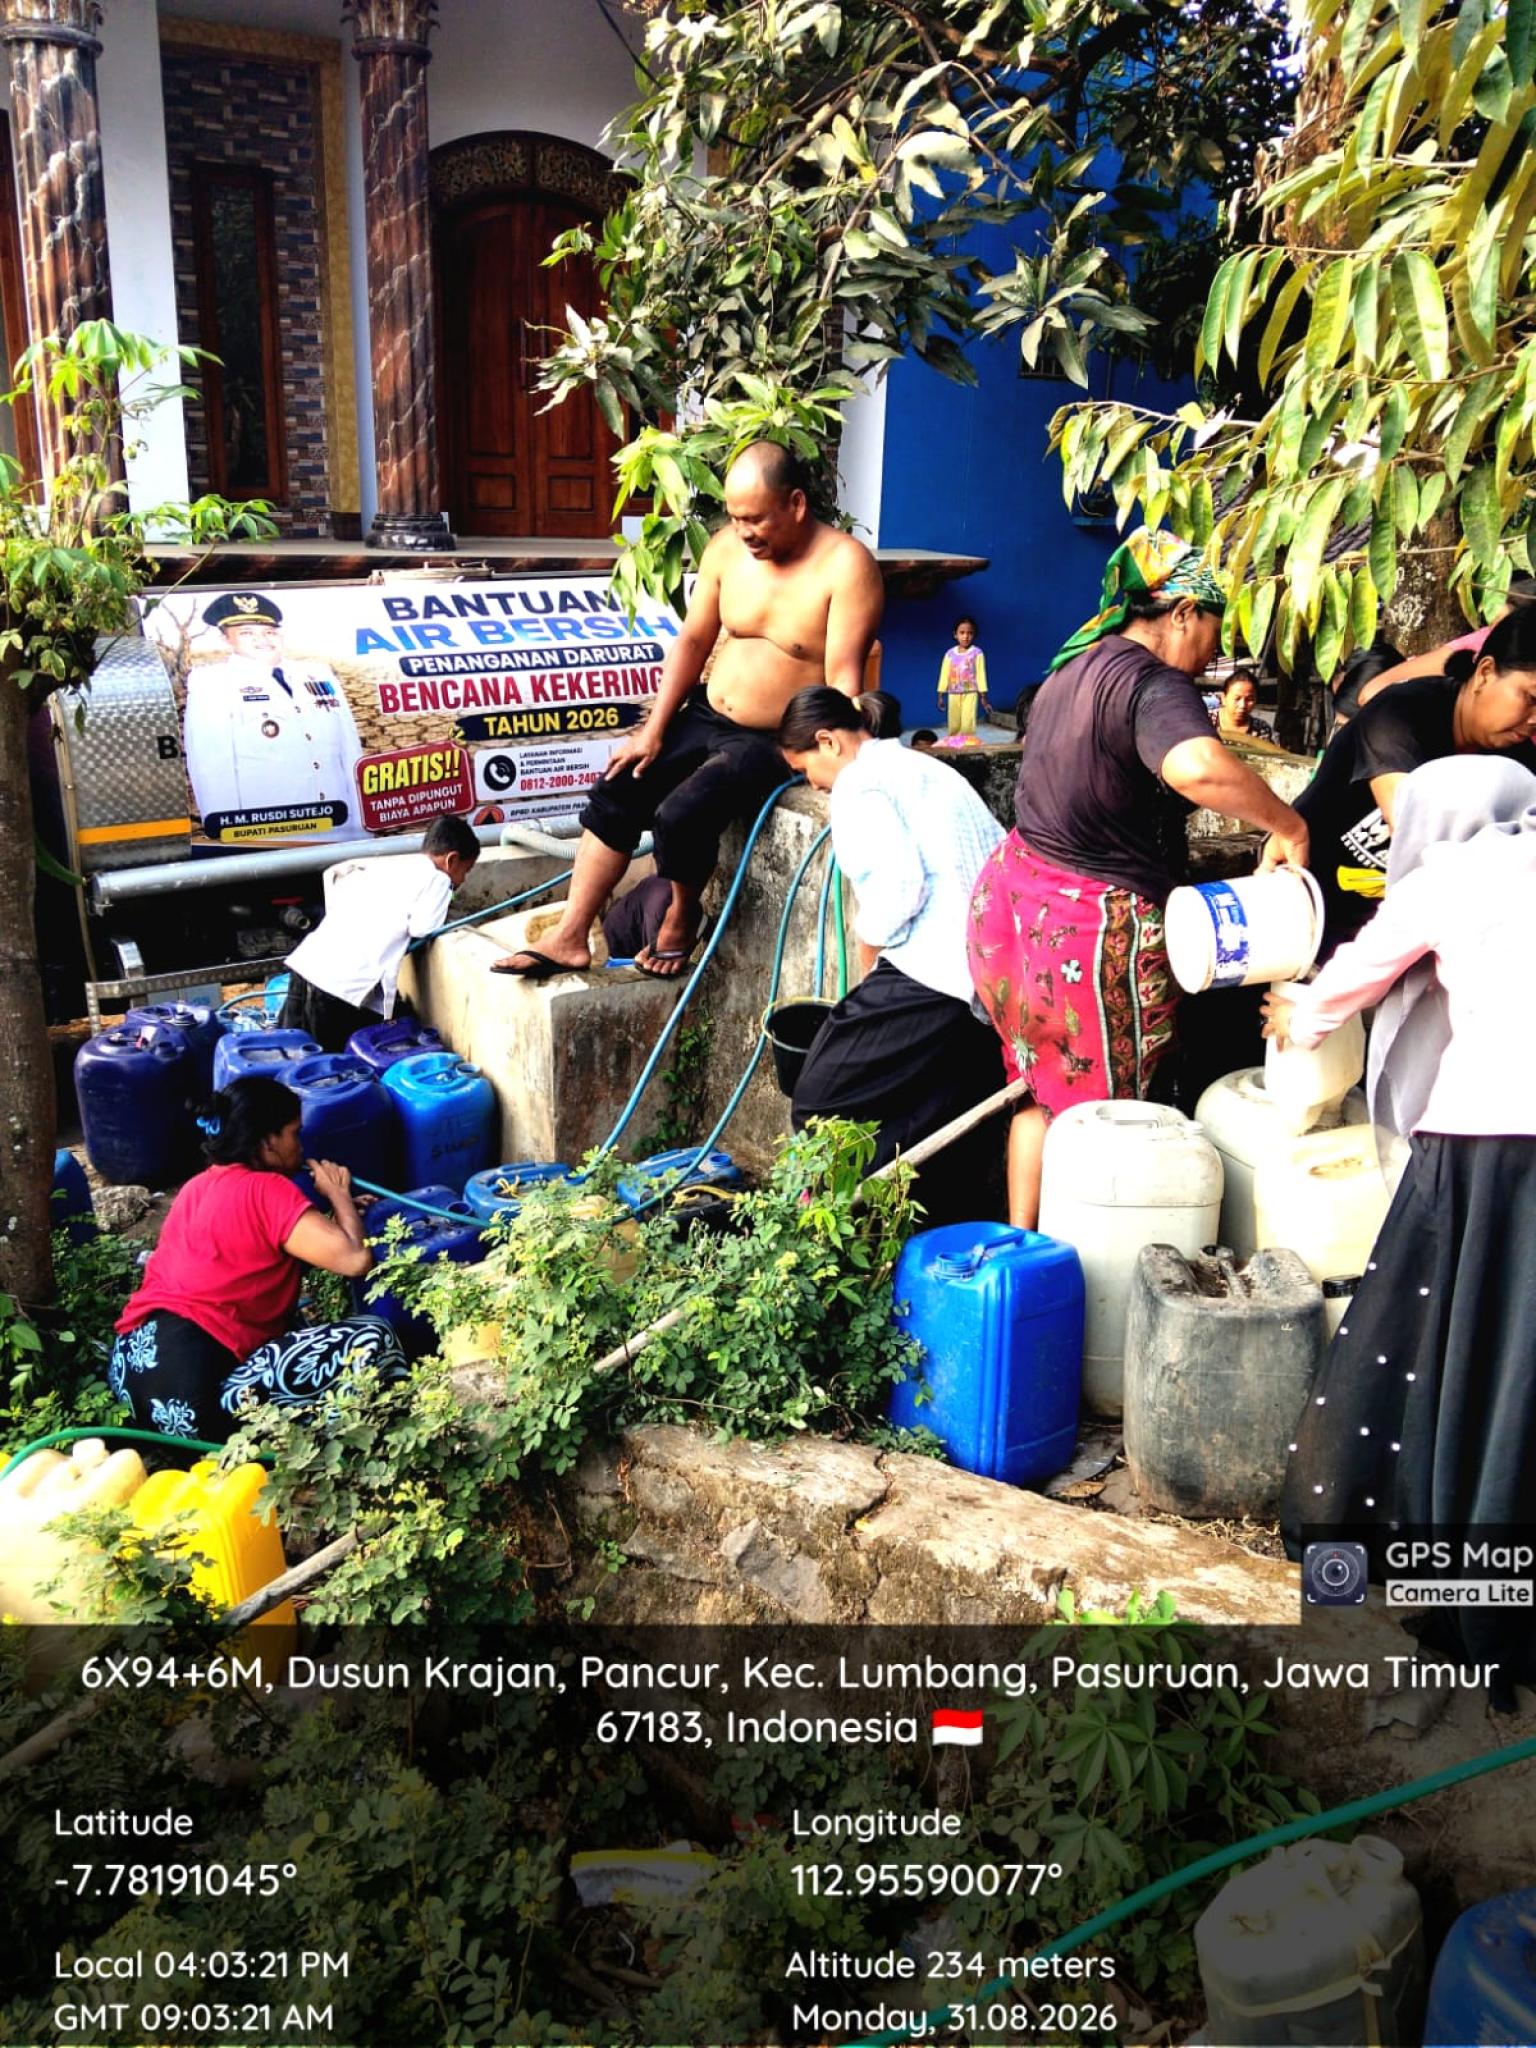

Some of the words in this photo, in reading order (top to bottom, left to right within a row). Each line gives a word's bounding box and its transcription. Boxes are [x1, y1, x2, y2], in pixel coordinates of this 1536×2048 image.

[382, 590, 621, 621] BANTUAN
[356, 623, 460, 655] AIR
[467, 616, 679, 645] BERSIH
[408, 650, 560, 674] PENANGANAN
[564, 644, 655, 665] DARURAT
[379, 676, 522, 713] BENCANA
[484, 713, 560, 737] TAHUN
[566, 708, 619, 731] 2026
[363, 748, 461, 795] GRATIS!!
[520, 767, 552, 776] BANTUAN
[370, 796, 406, 811] TANPA
[408, 784, 462, 804] DIPUNGUT
[380, 808, 410, 822] BIAYA
[413, 799, 456, 815] APAPUN
[220, 816, 233, 826] H.
[234, 814, 249, 824] M.
[251, 810, 287, 822] RUSDI
[289, 805, 333, 818] SUTEJO
[233, 828, 266, 838] BUPATI
[268, 822, 317, 833] PASURUAN
